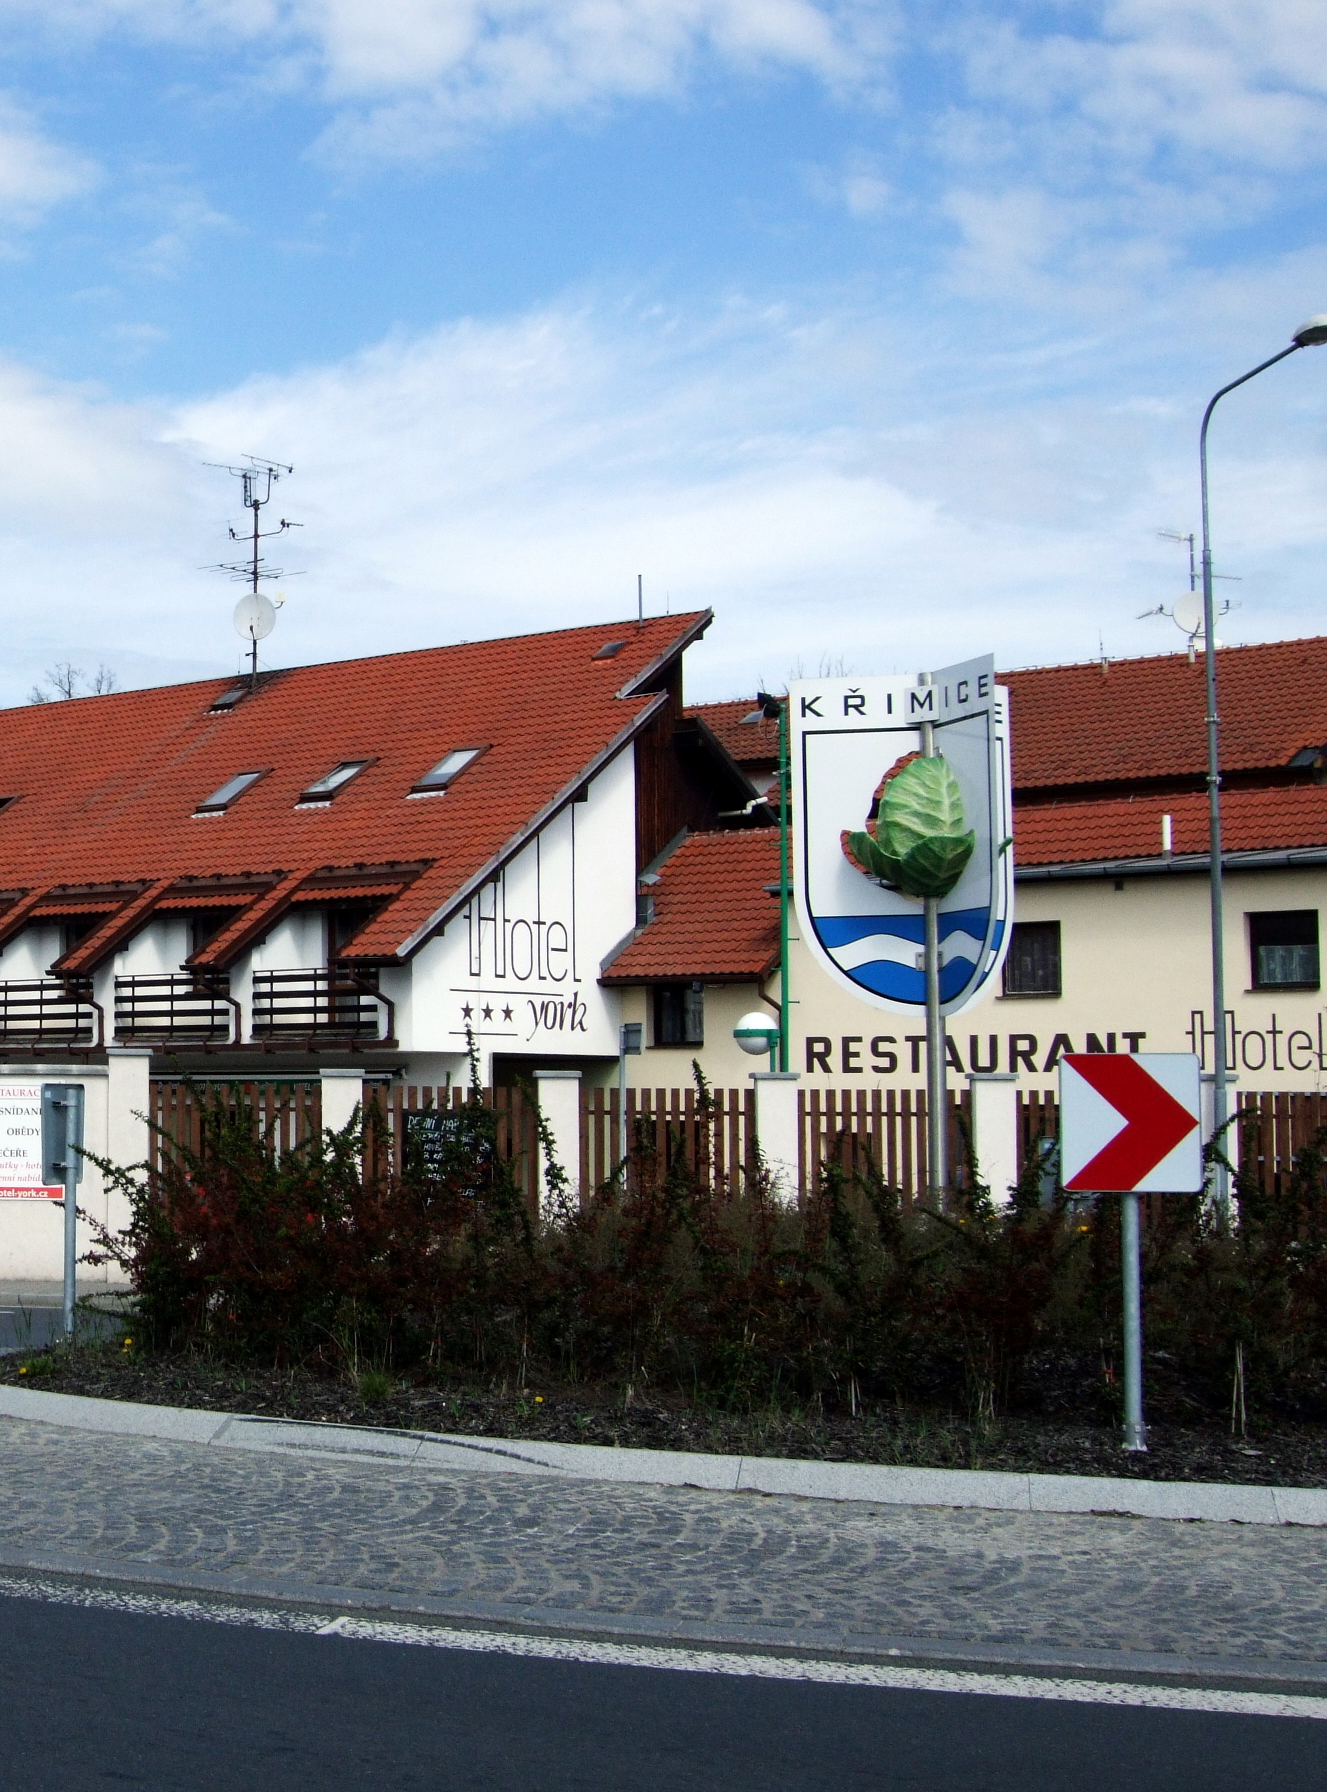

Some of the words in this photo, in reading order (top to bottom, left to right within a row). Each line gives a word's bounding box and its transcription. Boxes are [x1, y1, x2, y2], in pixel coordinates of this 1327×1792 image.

[462, 802, 582, 983] Hotel
[525, 991, 588, 1042] york
[1185, 1009, 1327, 1071] Hotel
[6, 1126, 41, 1136] OBĚDY
